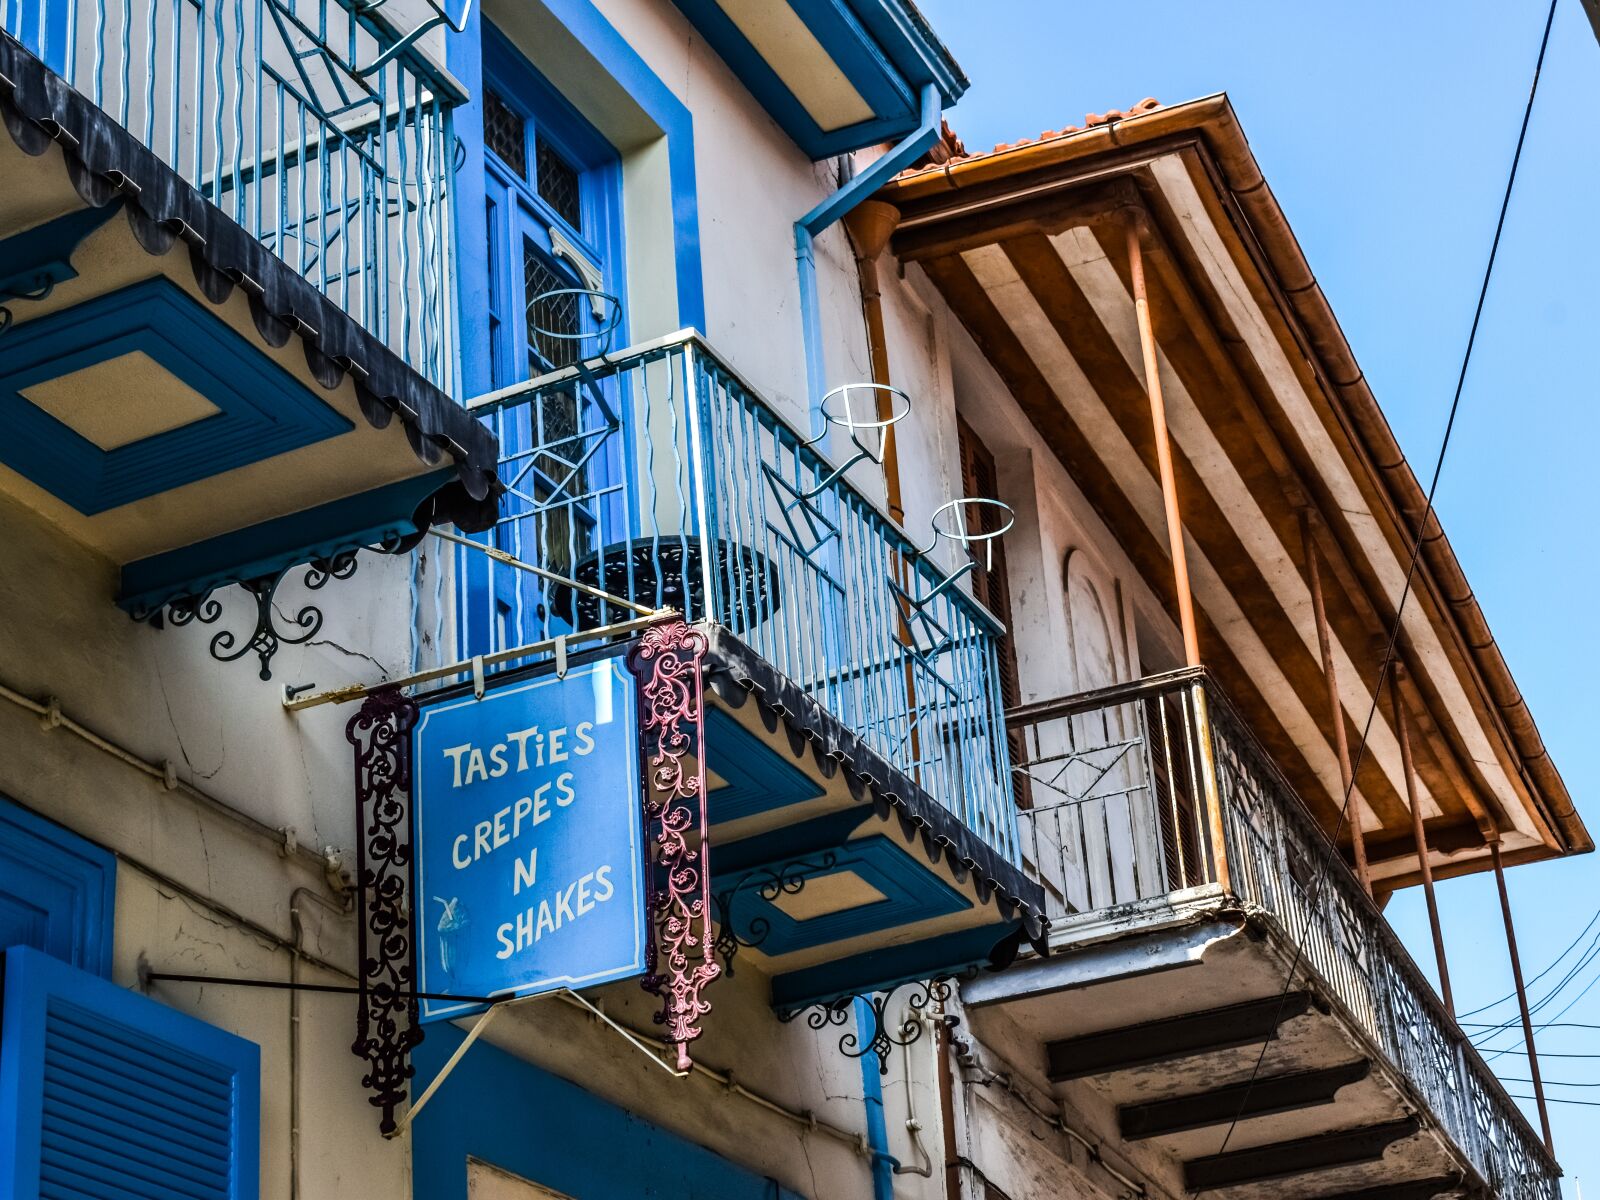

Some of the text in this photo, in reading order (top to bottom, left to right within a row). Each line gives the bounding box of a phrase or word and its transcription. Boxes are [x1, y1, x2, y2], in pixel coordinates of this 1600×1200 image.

[452, 772, 575, 870] CREPES
[496, 865, 614, 960] SHAKES
[513, 848, 538, 896] N
